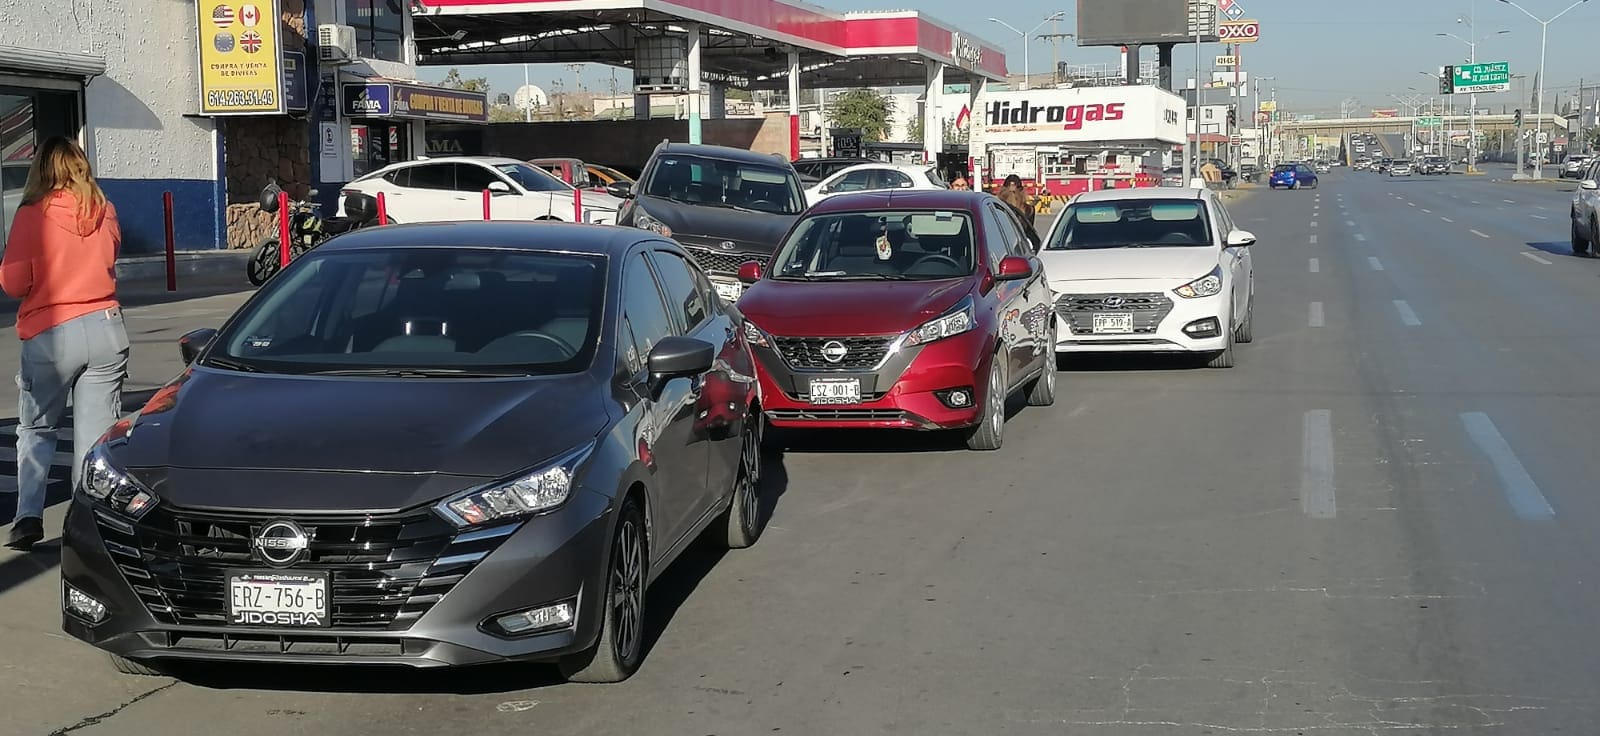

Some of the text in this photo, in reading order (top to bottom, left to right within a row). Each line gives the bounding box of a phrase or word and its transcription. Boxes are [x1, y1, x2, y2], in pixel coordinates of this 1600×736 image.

[1219, 24, 1257, 39] OXXO
[352, 100, 382, 110] FAMA
[410, 93, 434, 111] COMPRA
[985, 100, 1125, 131] Hidrogas
[814, 397, 858, 405] JIDOSHA
[255, 538, 308, 549] NISSN
[232, 585, 325, 610] ERZ-756-B
[234, 613, 321, 625] JIDOSHA
